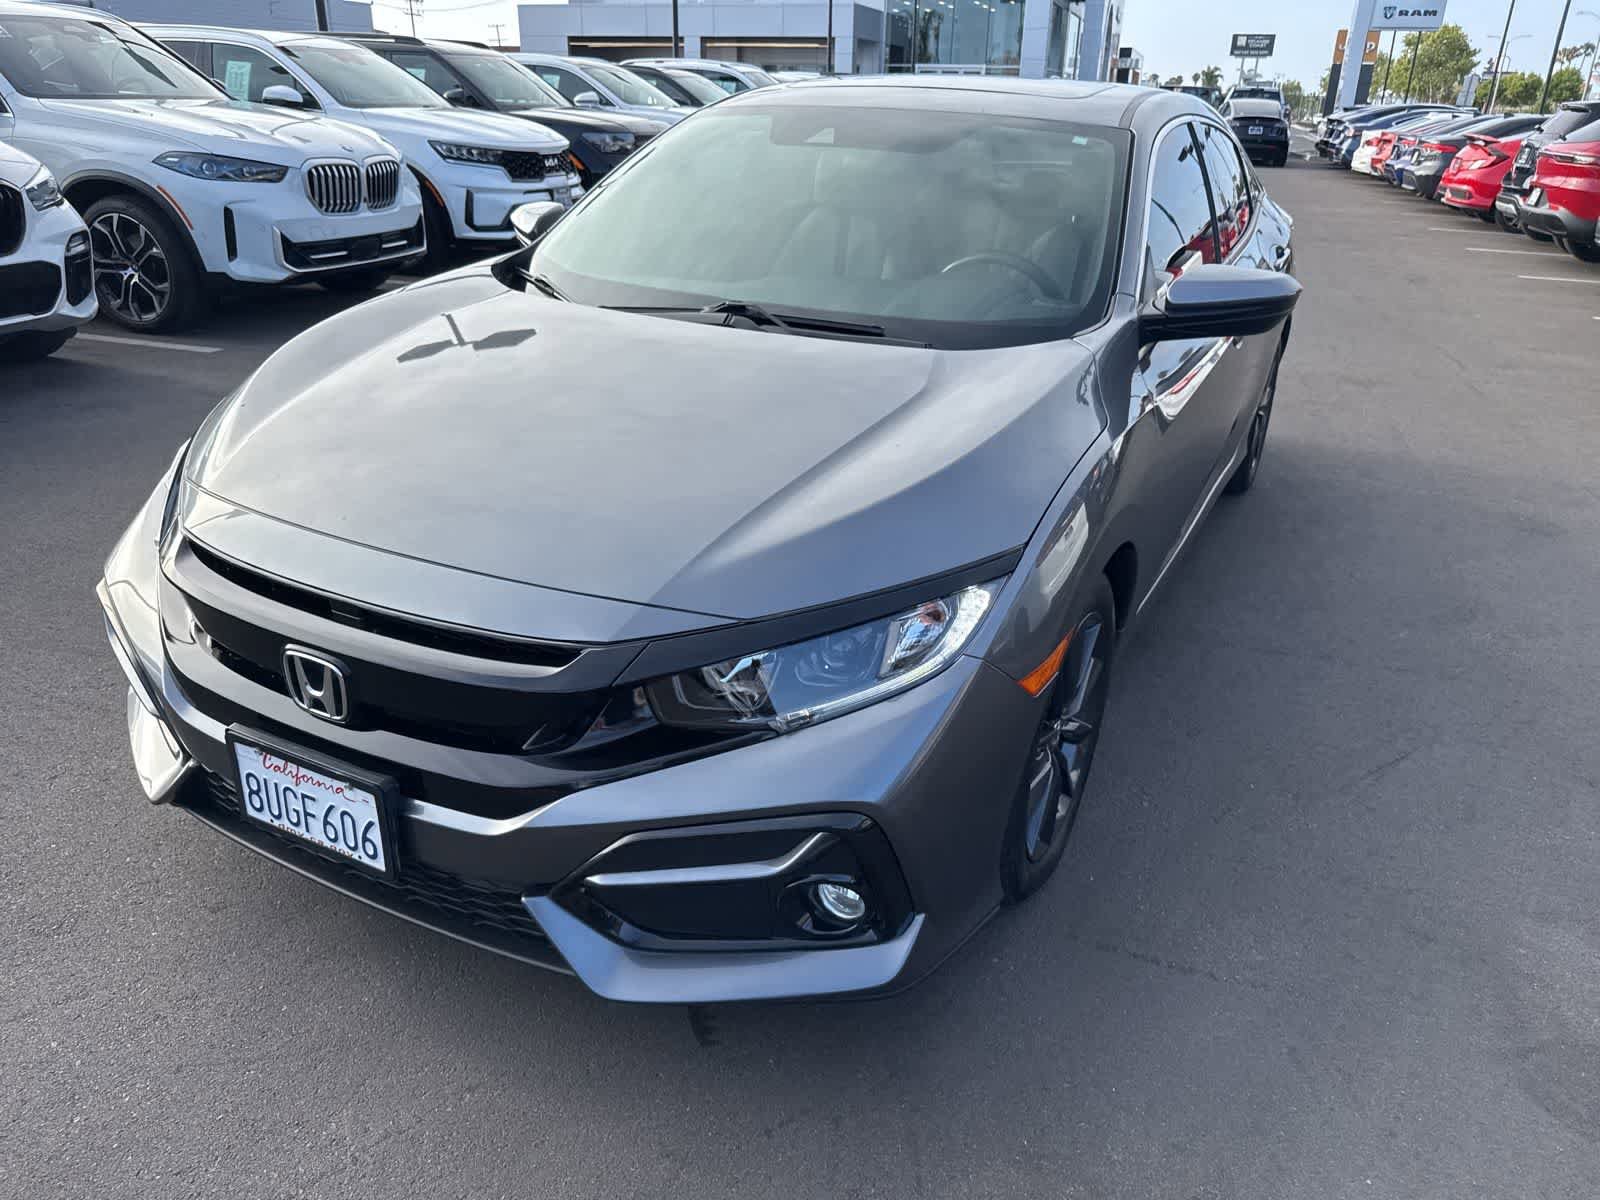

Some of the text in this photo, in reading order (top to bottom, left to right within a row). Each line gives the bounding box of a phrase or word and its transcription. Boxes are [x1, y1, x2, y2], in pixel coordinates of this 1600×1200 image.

[1398, 9, 1438, 17] RAM
[261, 752, 358, 803] California
[245, 772, 378, 860] 8UGF606
